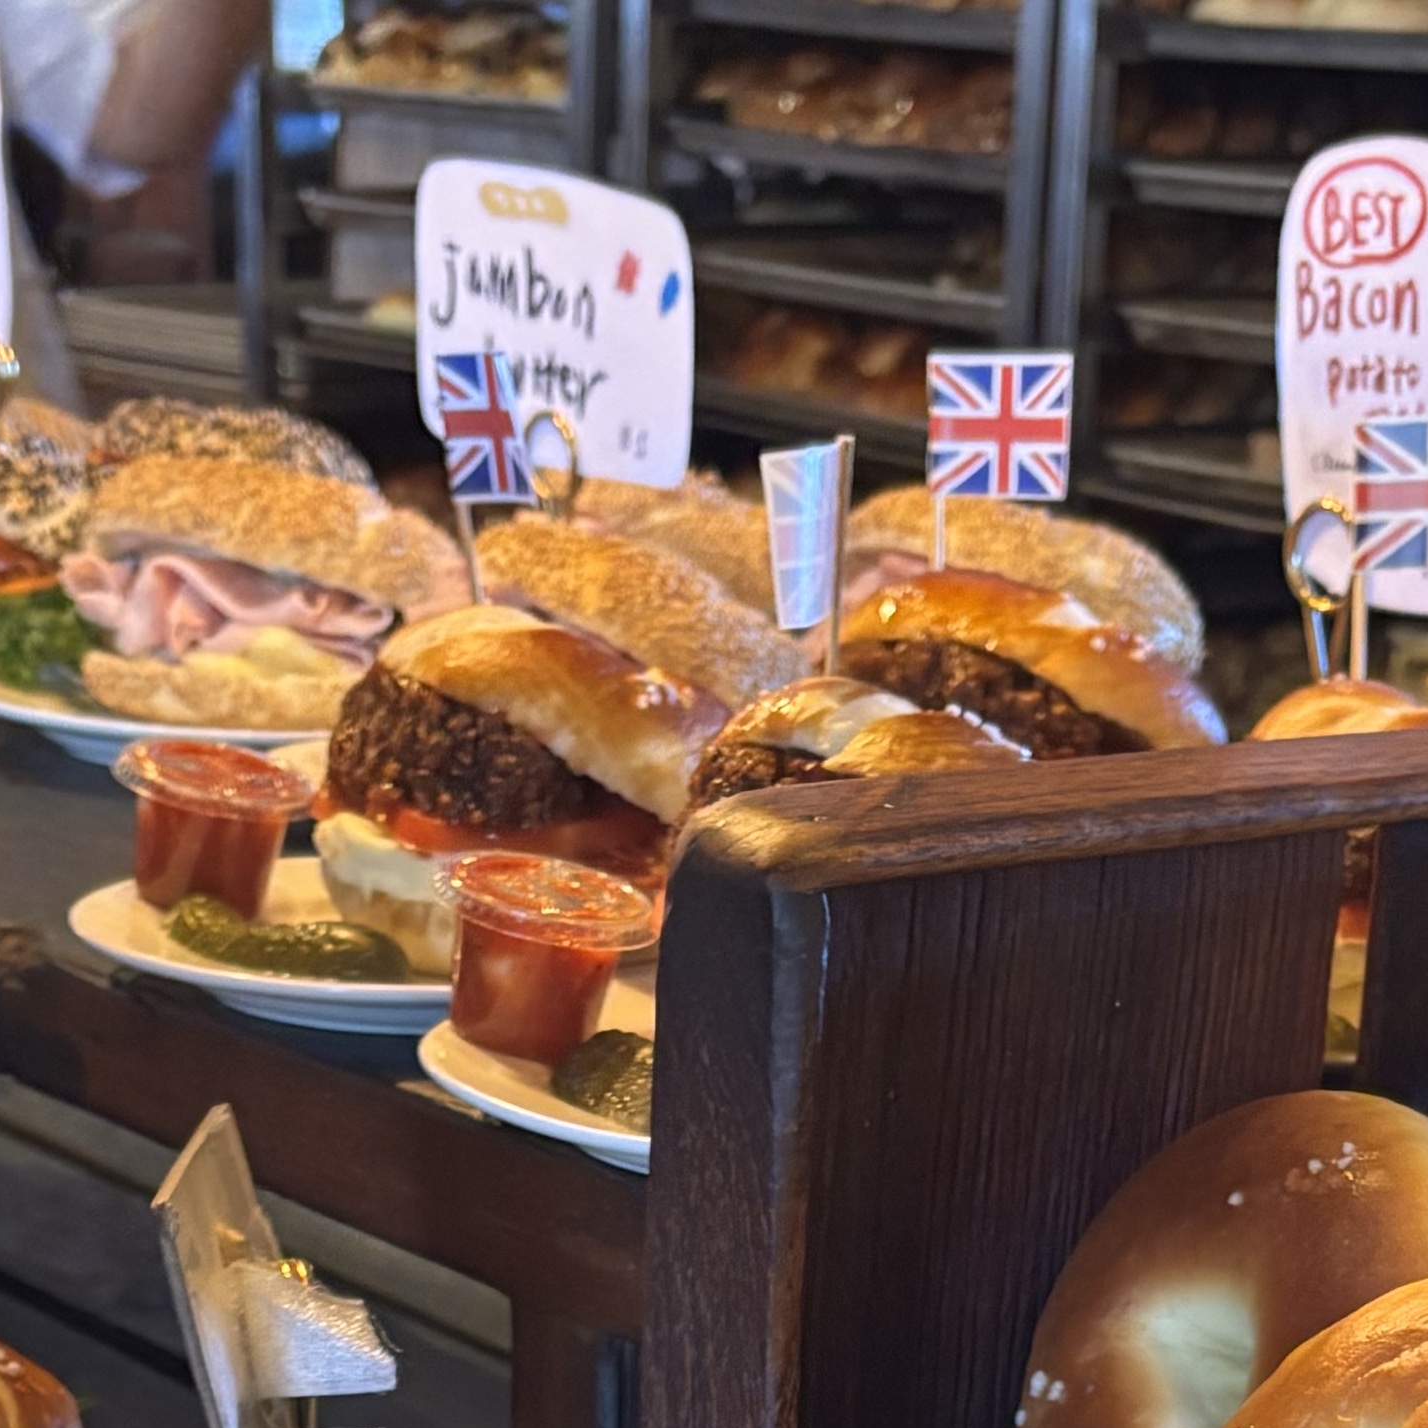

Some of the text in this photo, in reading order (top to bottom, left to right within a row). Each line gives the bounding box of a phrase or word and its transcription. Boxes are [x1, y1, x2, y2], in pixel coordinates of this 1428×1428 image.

[1323, 187, 1405, 255] BEST
[1295, 260, 1419, 341] Bacon
[482, 335, 611, 420] utter
[1326, 351, 1420, 406] potato
